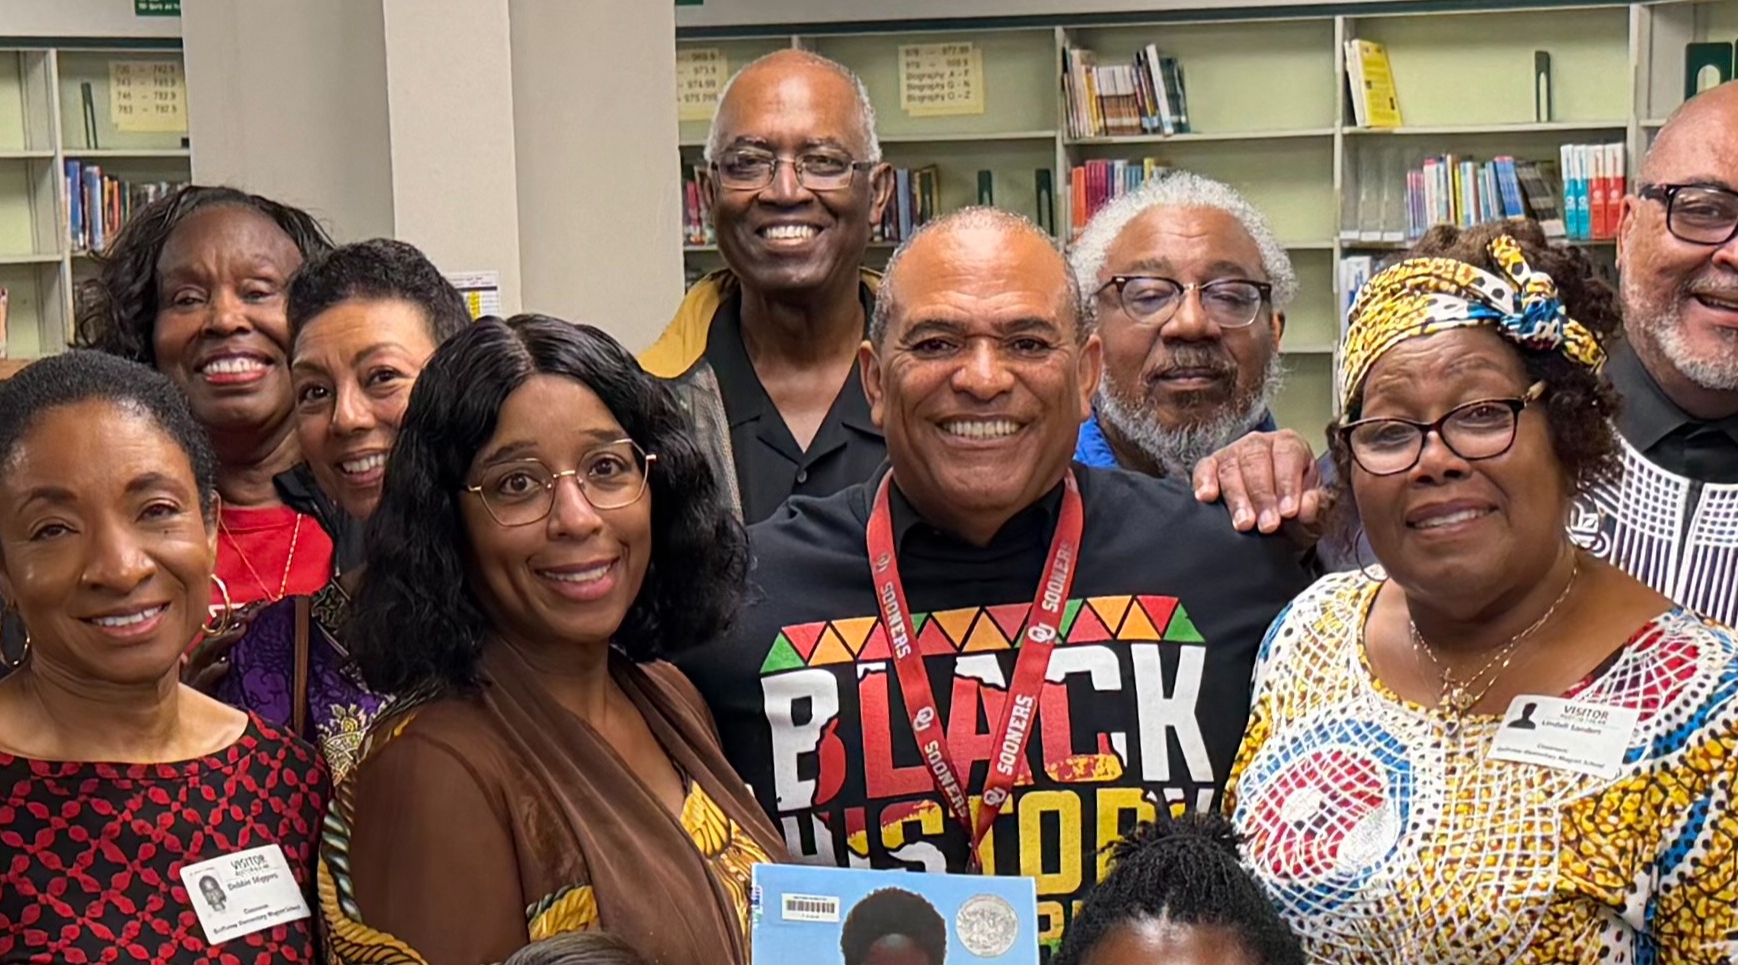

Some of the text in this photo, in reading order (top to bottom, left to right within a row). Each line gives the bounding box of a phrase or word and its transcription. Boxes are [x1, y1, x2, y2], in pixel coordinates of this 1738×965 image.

[880, 581, 912, 659] SOONERS
[760, 643, 1215, 812] BLACK
[997, 694, 1034, 776] SOONERS
[1564, 704, 1610, 720] VISITOR
[230, 854, 266, 870] VISITOR
